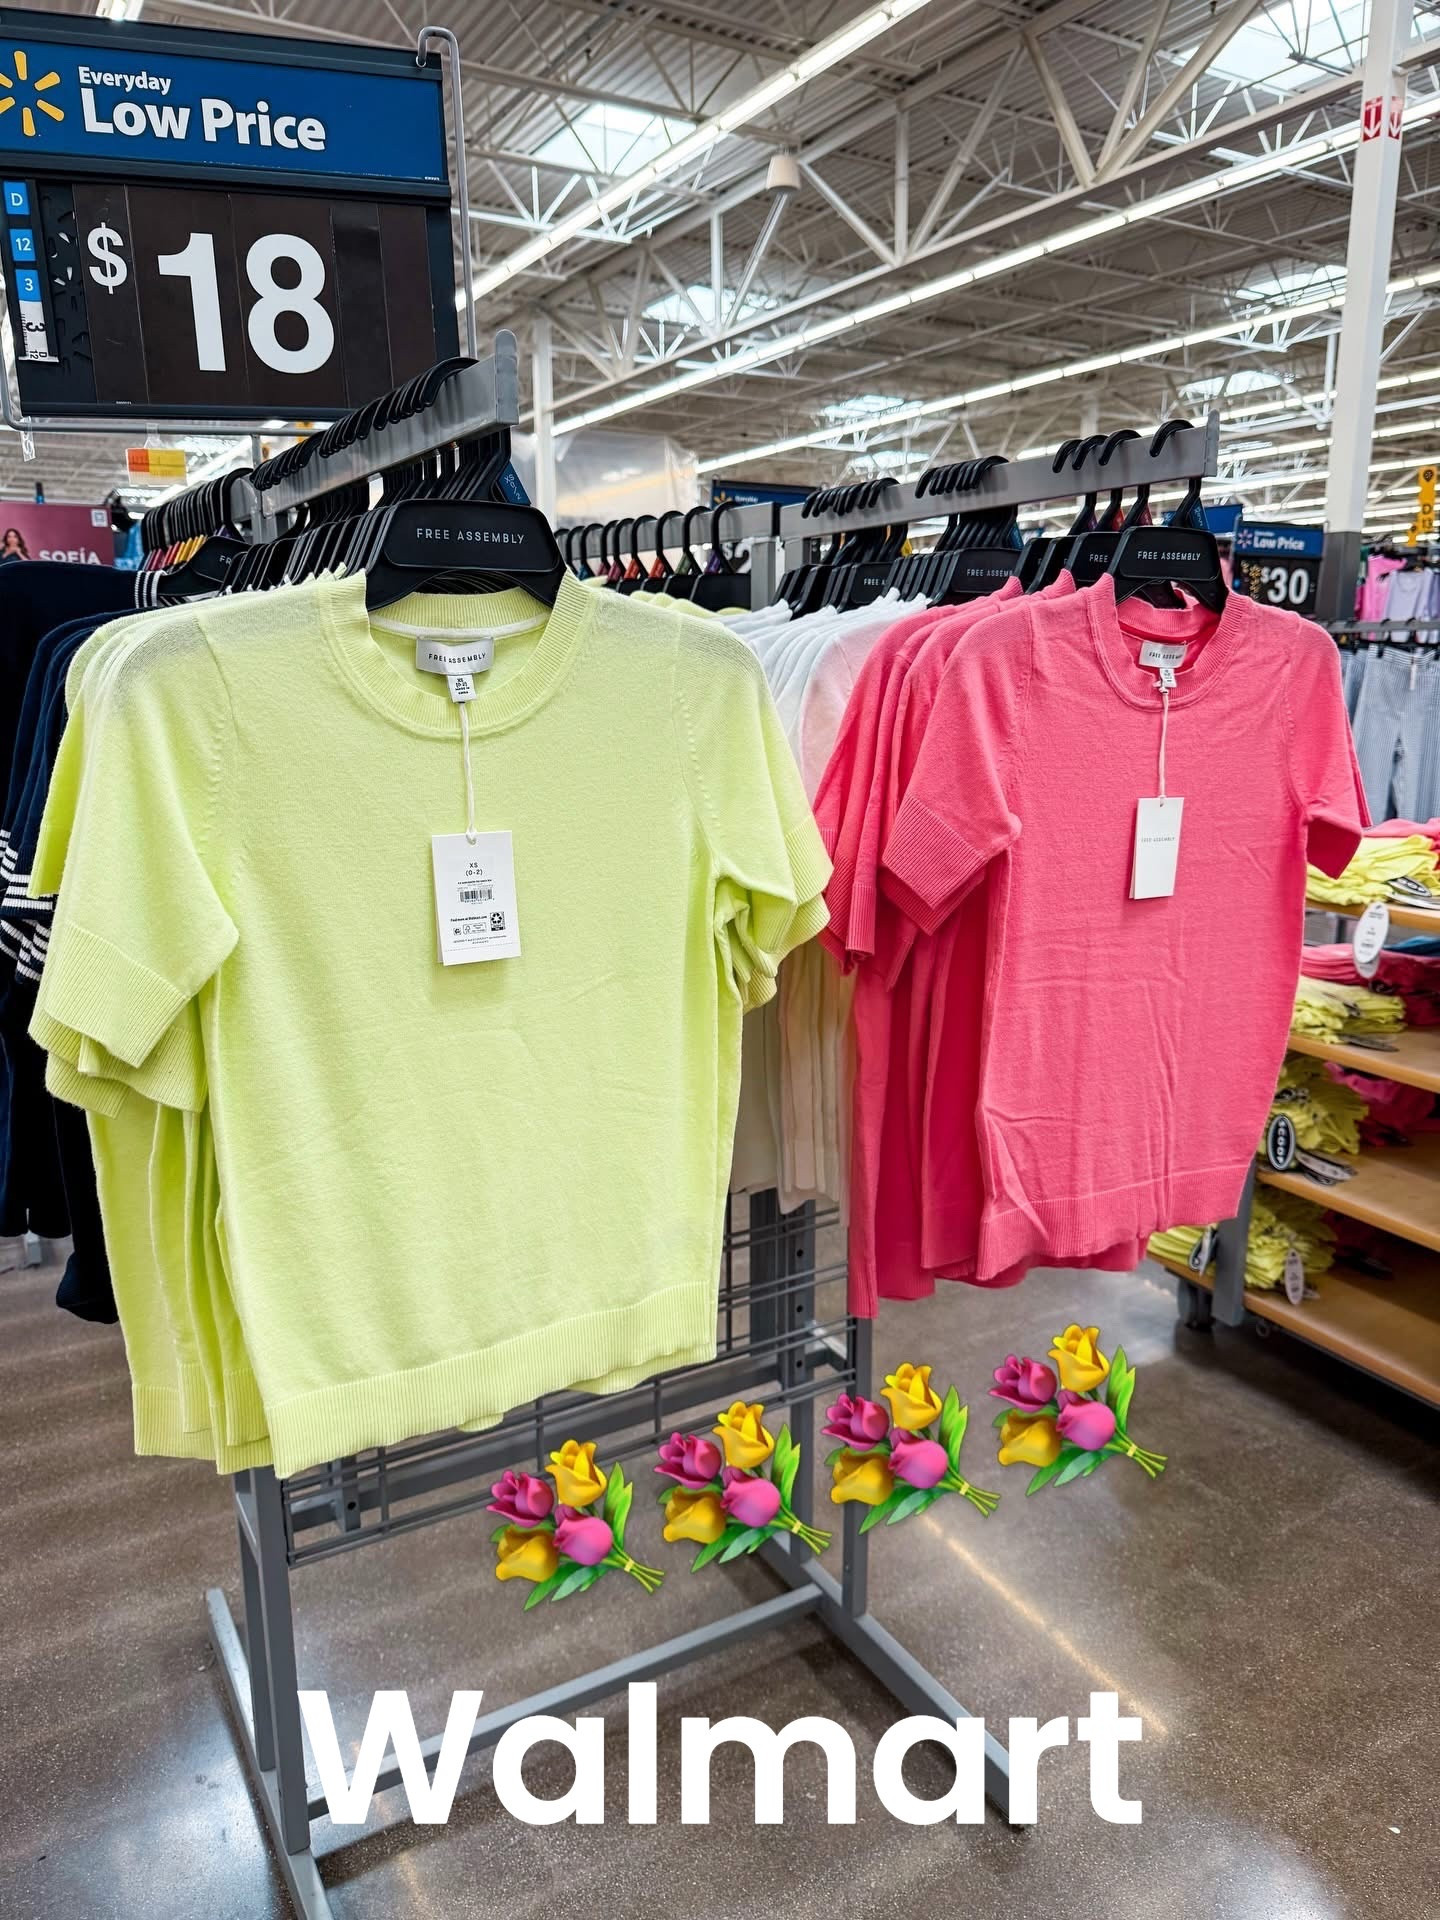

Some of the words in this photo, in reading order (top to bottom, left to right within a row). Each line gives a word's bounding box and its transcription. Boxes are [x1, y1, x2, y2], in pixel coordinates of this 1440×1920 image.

[79, 66, 172, 95] Everyday
[81, 88, 190, 140] Low
[202, 98, 326, 151] Price
[11, 192, 23, 206] D
[16, 237, 32, 252] 12
[24, 278, 34, 291] 3
[158, 232, 334, 374] 18
[416, 528, 450, 540] FREE
[457, 530, 525, 545] ASSEMBLY
[1089, 553, 1109, 563] FREE
[1137, 551, 1158, 560] FREE
[1161, 552, 1201, 561] ASSEMBLY
[967, 569, 984, 577] FREE
[863, 578, 879, 586] FREE
